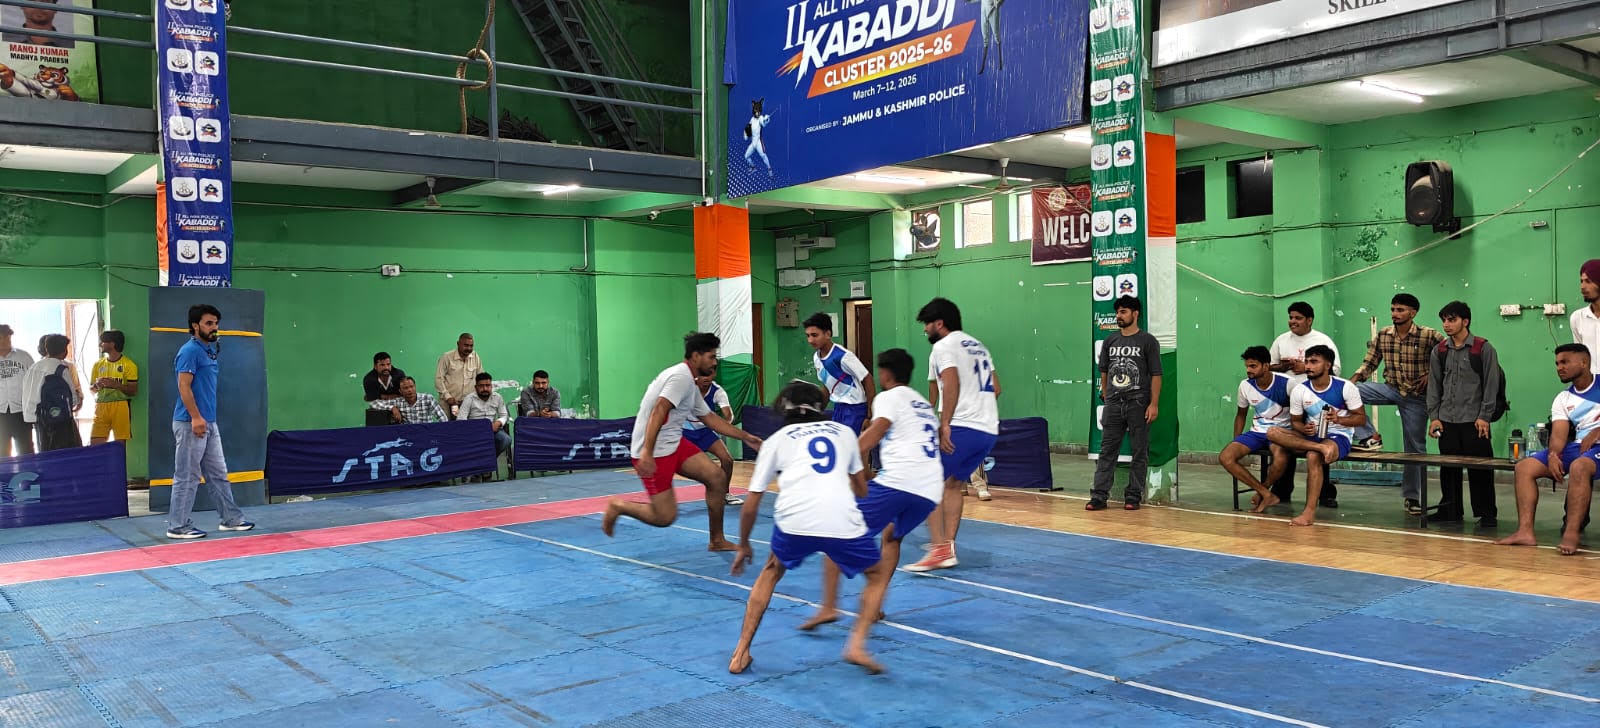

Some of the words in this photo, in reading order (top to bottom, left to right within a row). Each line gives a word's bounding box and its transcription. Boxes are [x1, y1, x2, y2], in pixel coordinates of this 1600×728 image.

[172, 27, 211, 37] KABADDI
[783, 0, 810, 50] II
[813, 0, 838, 20] ALL
[9, 44, 38, 54] MANOJ
[40, 47, 69, 57] KUMAR
[795, 0, 956, 89] KABADDI
[10, 53, 38, 62] MADHYA
[40, 55, 69, 64] PRADESH
[824, 55, 886, 87] CLUSTER
[853, 86, 875, 100] March
[898, 74, 917, 88] 2026
[806, 122, 832, 133] ORGANISED
[842, 110, 873, 126] JAMMU
[875, 107, 882, 117] &
[883, 95, 927, 116] KASHMIR
[928, 84, 966, 104] POLICE
[1095, 119, 1127, 131] KABADDI
[175, 155, 213, 164] KABADDI
[1095, 185, 1129, 198] KABADDI
[1041, 213, 1090, 246] WELC
[1096, 251, 1129, 263] KABADDI
[1097, 317, 1117, 326] KABA
[1109, 346, 1141, 357] DIOR
[973, 359, 995, 392] 12
[561, 443, 633, 460] STA
[808, 436, 836, 474] 9
[332, 447, 443, 483] STAG
[0, 471, 41, 505] G
